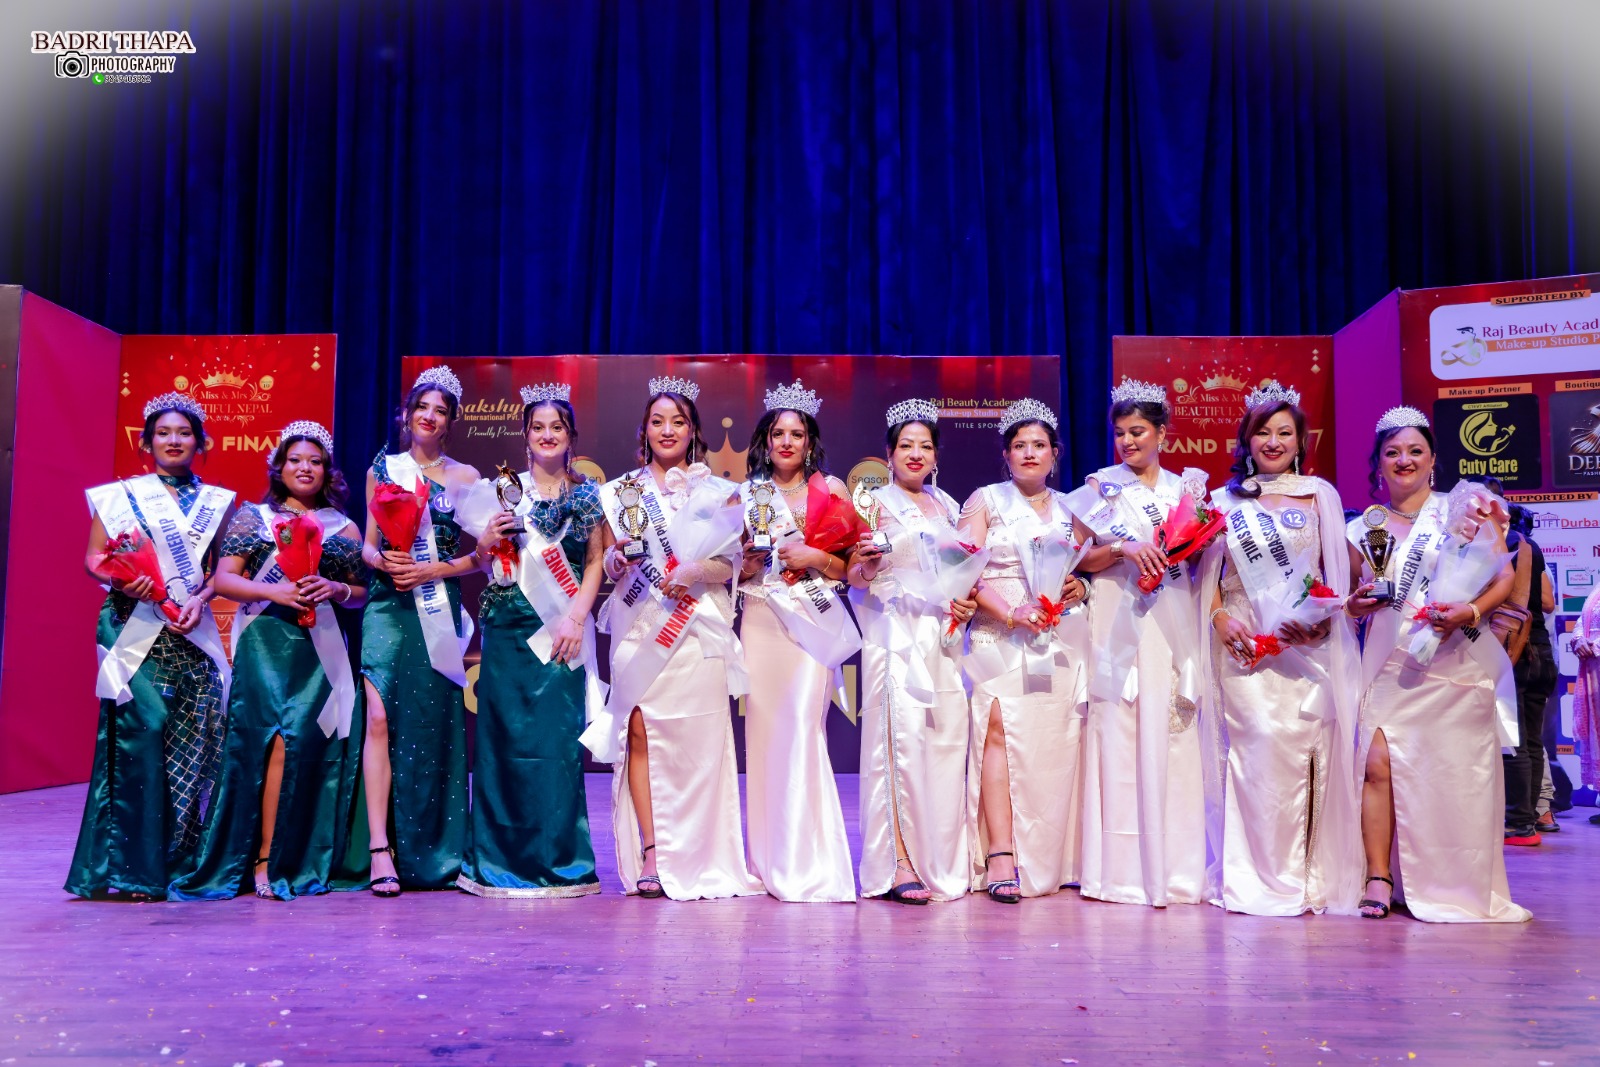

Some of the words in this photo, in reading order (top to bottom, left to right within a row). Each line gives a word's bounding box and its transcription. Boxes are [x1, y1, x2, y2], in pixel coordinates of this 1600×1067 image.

[1495, 292, 1569, 305] SUPPORTED
[1571, 290, 1586, 299] BY
[1482, 326, 1504, 339] Raj
[1508, 321, 1558, 336] Beauty
[1496, 338, 1546, 351] Make-up
[1550, 335, 1589, 346] Studio
[200, 391, 219, 399] Miss
[231, 391, 248, 399] Mrs
[1200, 394, 1220, 402] Miss
[1231, 394, 1245, 402] Mr
[1448, 388, 1486, 397] Make-up
[1488, 385, 1521, 394] Partner
[202, 403, 234, 413] TIFUL
[237, 403, 273, 413] NEPAL
[459, 398, 525, 416] akshy
[930, 397, 945, 408] Raj
[947, 397, 980, 408] Beauty
[464, 413, 506, 421] International
[507, 413, 520, 421] Pvt.
[938, 409, 972, 418] Make-up
[974, 409, 999, 417] Studio
[1174, 406, 1234, 416] BEAUTIFUL
[467, 426, 495, 439] Proudly
[1160, 437, 1218, 455] RAND
[1459, 458, 1487, 476] Cuty
[1489, 457, 1518, 474] Care
[851, 475, 890, 484] Season
[1503, 492, 1575, 502] SUPPORTED
[1577, 492, 1593, 500] BY
[191, 504, 216, 534] CHOICE
[642, 491, 668, 537] PHOTOGENIC
[1142, 502, 1166, 529] HOICE
[1229, 509, 1247, 533] BEST
[1286, 513, 1302, 524] 12
[158, 517, 177, 533] UP
[413, 535, 428, 550] UP
[1237, 531, 1263, 564] SMILE
[1541, 545, 1576, 553] anzila's
[164, 531, 196, 580] RUNNER
[541, 543, 579, 599] WINNER
[1393, 561, 1419, 612] ORGANIZER
[1411, 532, 1432, 563] CHOICE
[622, 577, 646, 608] MOST
[810, 587, 832, 615] MOST
[654, 593, 700, 649] WINNER
